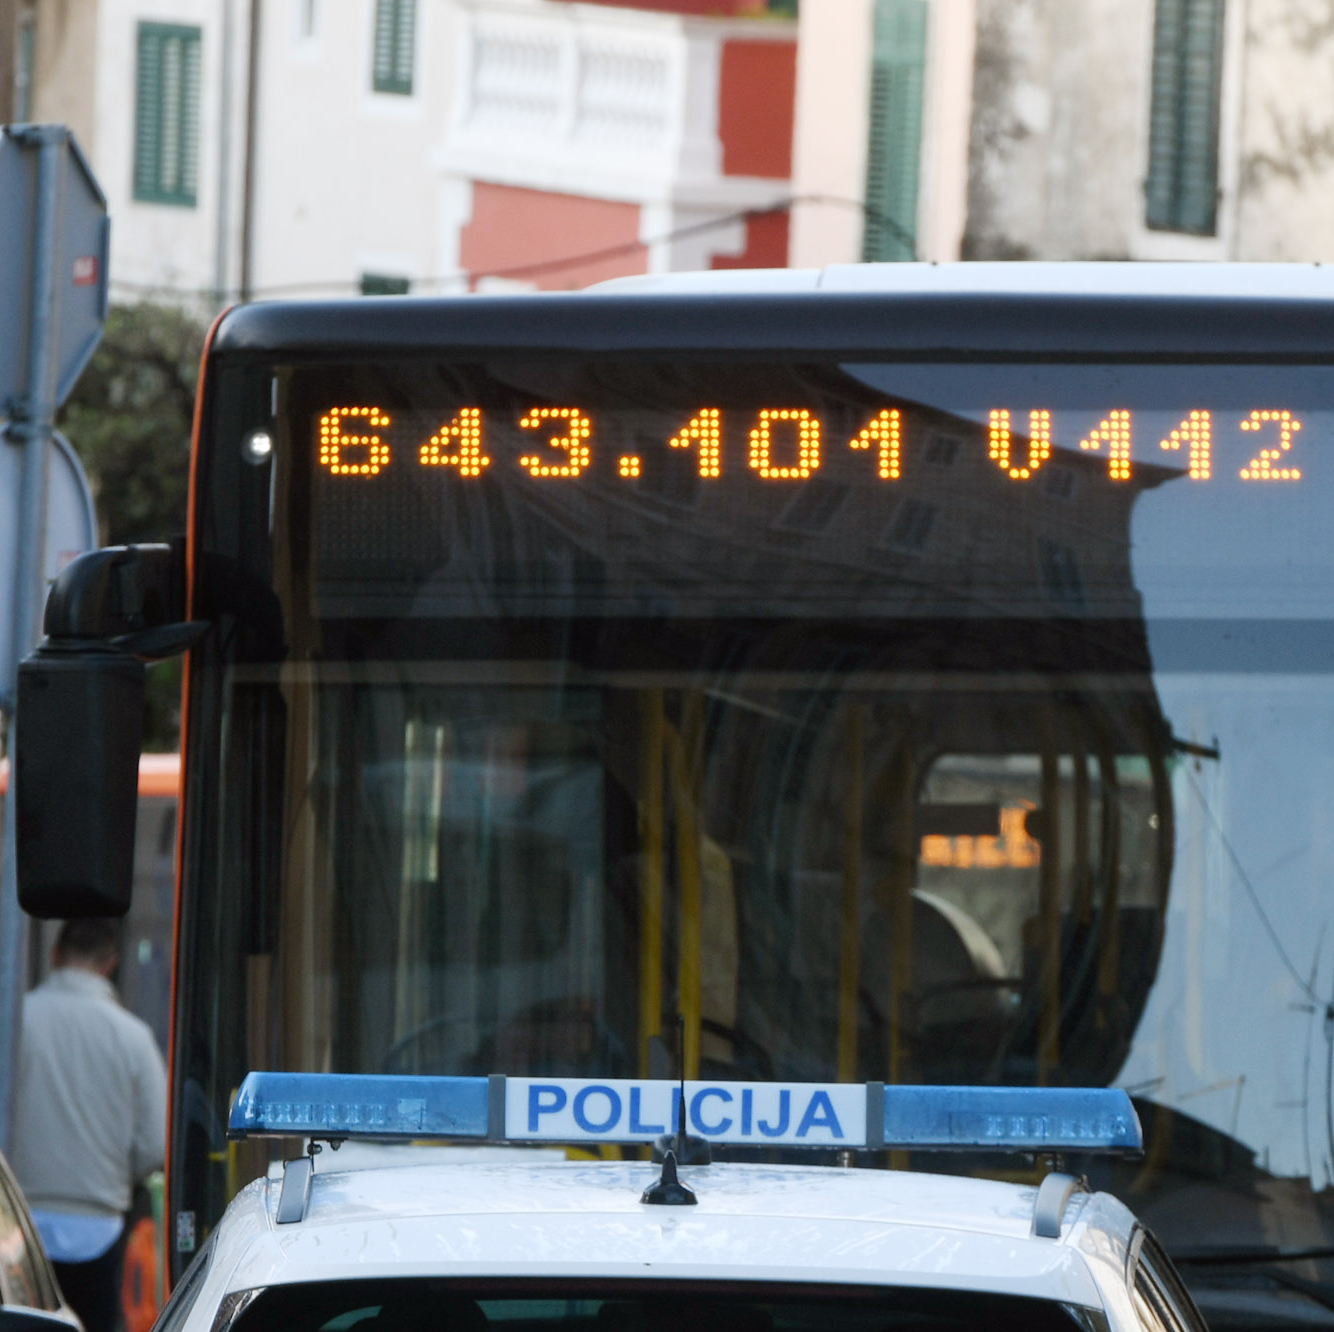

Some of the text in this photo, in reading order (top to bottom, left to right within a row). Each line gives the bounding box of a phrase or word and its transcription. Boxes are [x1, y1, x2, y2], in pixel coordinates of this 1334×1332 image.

[318, 405, 904, 481] 643.101
[988, 408, 1304, 482] V112
[527, 1084, 845, 1139] POLICIJA
